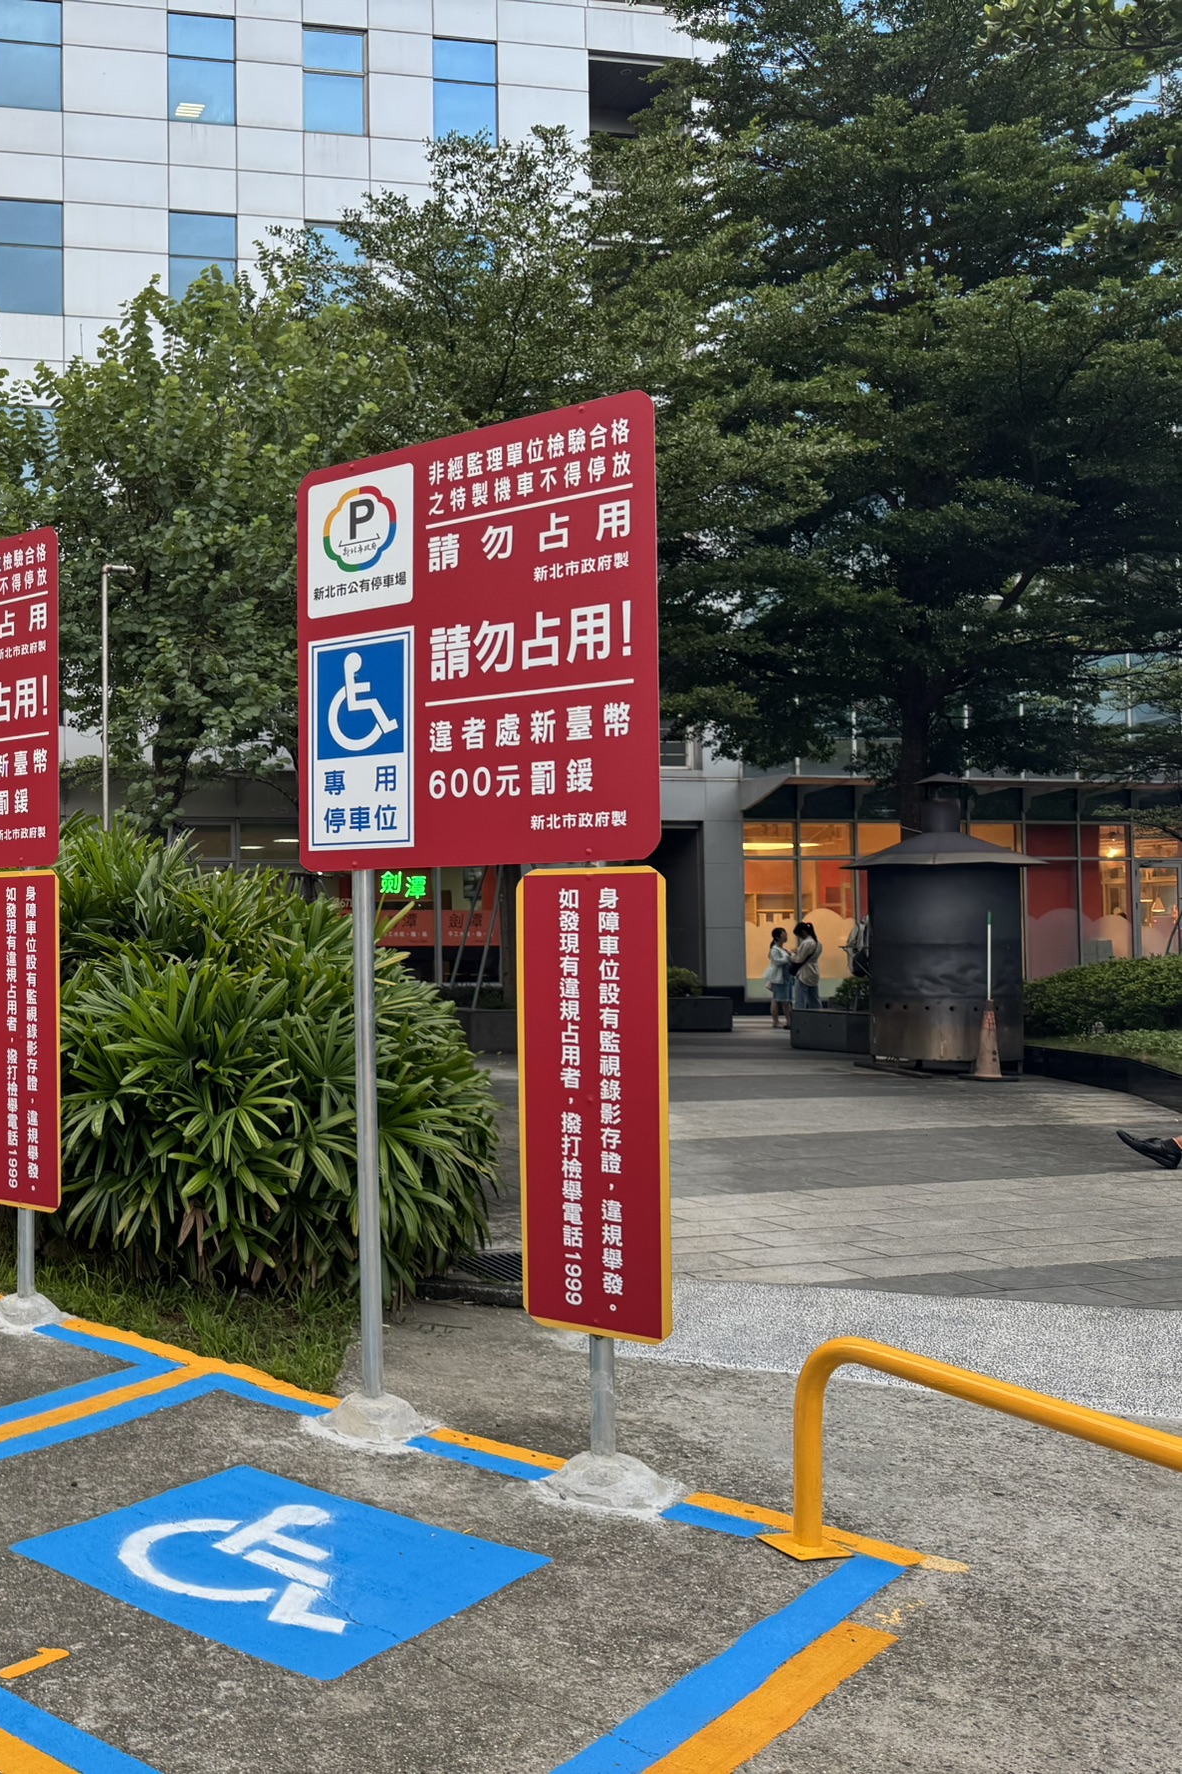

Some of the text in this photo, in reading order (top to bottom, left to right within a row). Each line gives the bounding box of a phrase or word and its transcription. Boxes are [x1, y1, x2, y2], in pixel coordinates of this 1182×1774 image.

[428, 417, 630, 486] 非經監理單位檢驗合格
[428, 451, 631, 516] 之特製機車不得停放
[350, 498, 375, 540] P
[427, 499, 631, 572] 請勿占用
[313, 571, 406, 601] 新北市公有停車場
[533, 552, 629, 582] 新北市政府製
[429, 600, 632, 681] 請勿占用!
[428, 702, 631, 754] 違者處新臺幣
[428, 758, 593, 799] 600元罰鍰
[323, 804, 398, 835] 停車位
[530, 809, 627, 831] 新北市政府製
[380, 870, 427, 899] 劍潭
